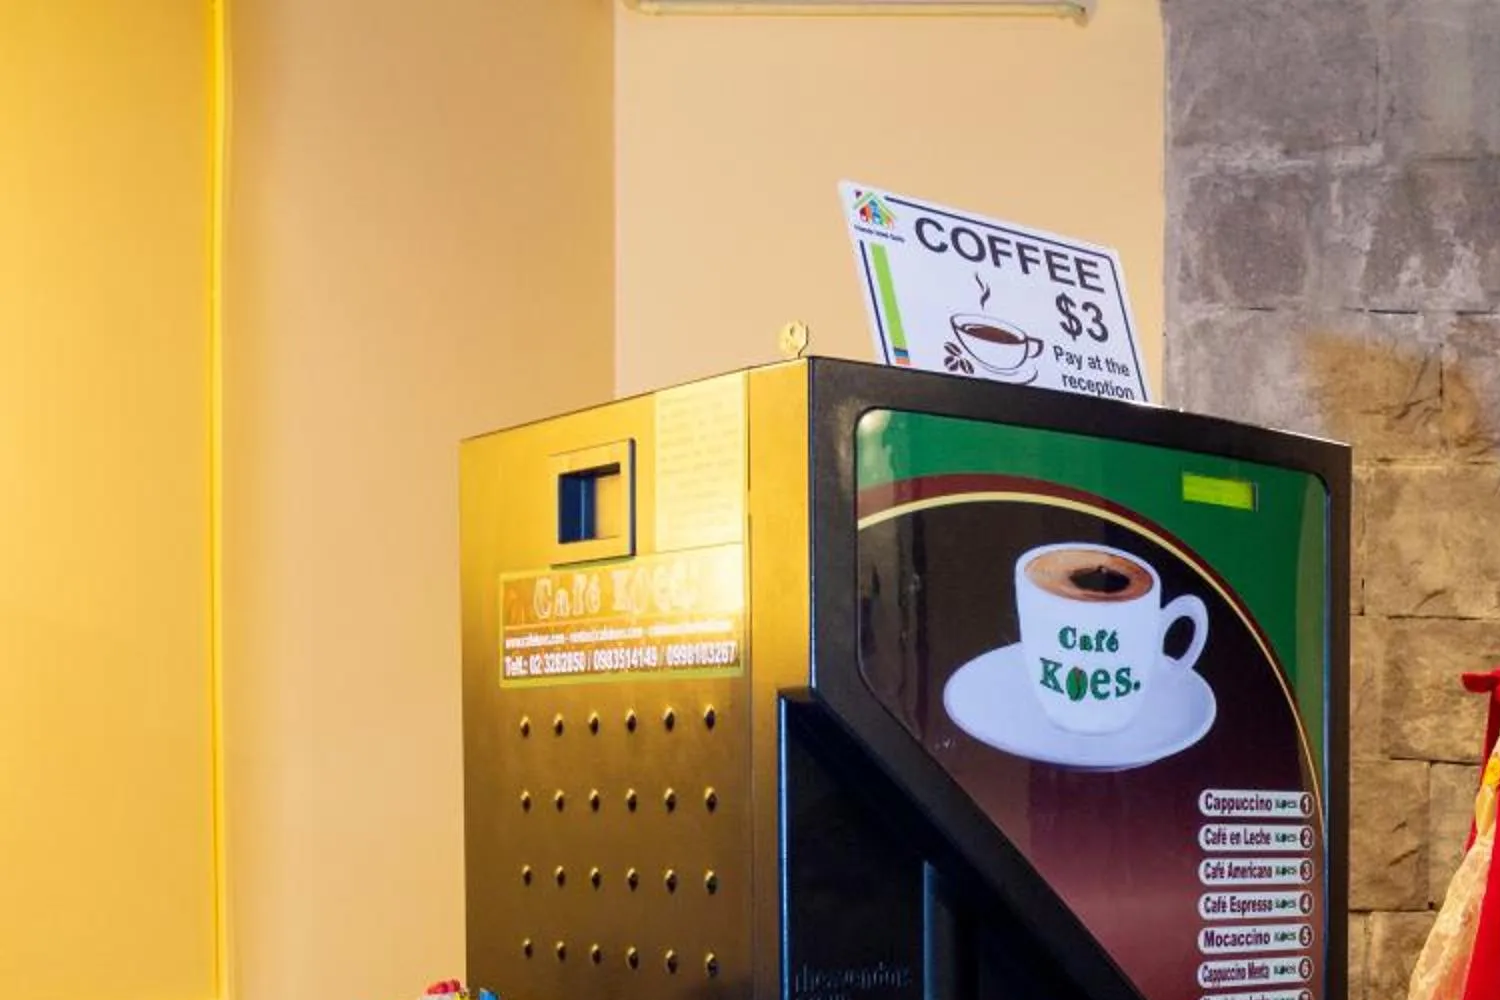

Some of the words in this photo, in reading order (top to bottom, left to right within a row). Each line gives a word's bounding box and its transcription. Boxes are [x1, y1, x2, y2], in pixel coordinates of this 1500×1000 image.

[914, 216, 1105, 294] COFFEE
[1055, 292, 1109, 343] $3
[1053, 345, 1083, 371] Pay
[1087, 355, 1103, 371] at
[1105, 357, 1131, 377] the
[1062, 374, 1135, 401] reception
[1058, 625, 1119, 653] Café
[1205, 792, 1273, 815] Cappuccino
[1204, 827, 1227, 845] Café
[1230, 831, 1241, 845] en
[1244, 827, 1271, 845] Leche
[1204, 862, 1225, 879] Café
[1227, 862, 1273, 879] Americano
[1204, 896, 1227, 913] Café
[1229, 896, 1273, 916] Espresso
[1204, 928, 1271, 948] Mocaccino
[1247, 962, 1270, 979] Menta
